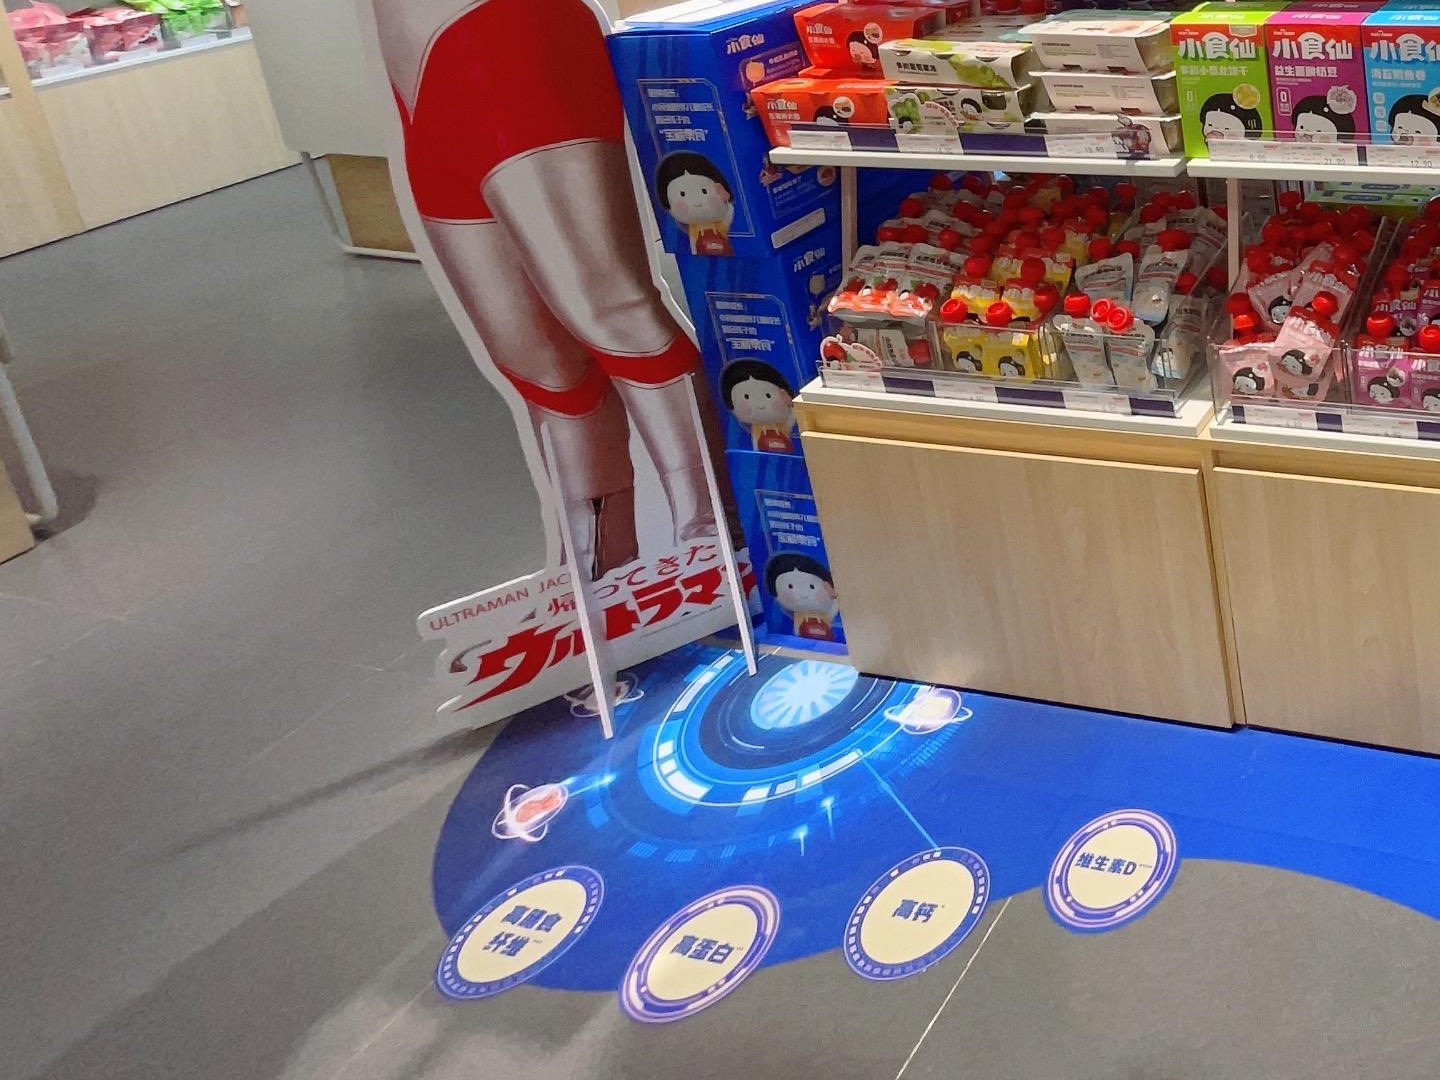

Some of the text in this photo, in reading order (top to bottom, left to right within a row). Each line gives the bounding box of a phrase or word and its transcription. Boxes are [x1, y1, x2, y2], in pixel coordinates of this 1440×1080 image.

[1178, 32, 1255, 59] 小食仙
[1272, 32, 1352, 60] 小食仙
[1274, 65, 1337, 78] 益生菌酸奶豆
[429, 572, 573, 631] ULTRAMAN JAC
[1074, 851, 1138, 876] 维生素D
[891, 899, 938, 923] 高钙
[482, 931, 531, 957] 纤维
[670, 934, 734, 964] 高蛋白
